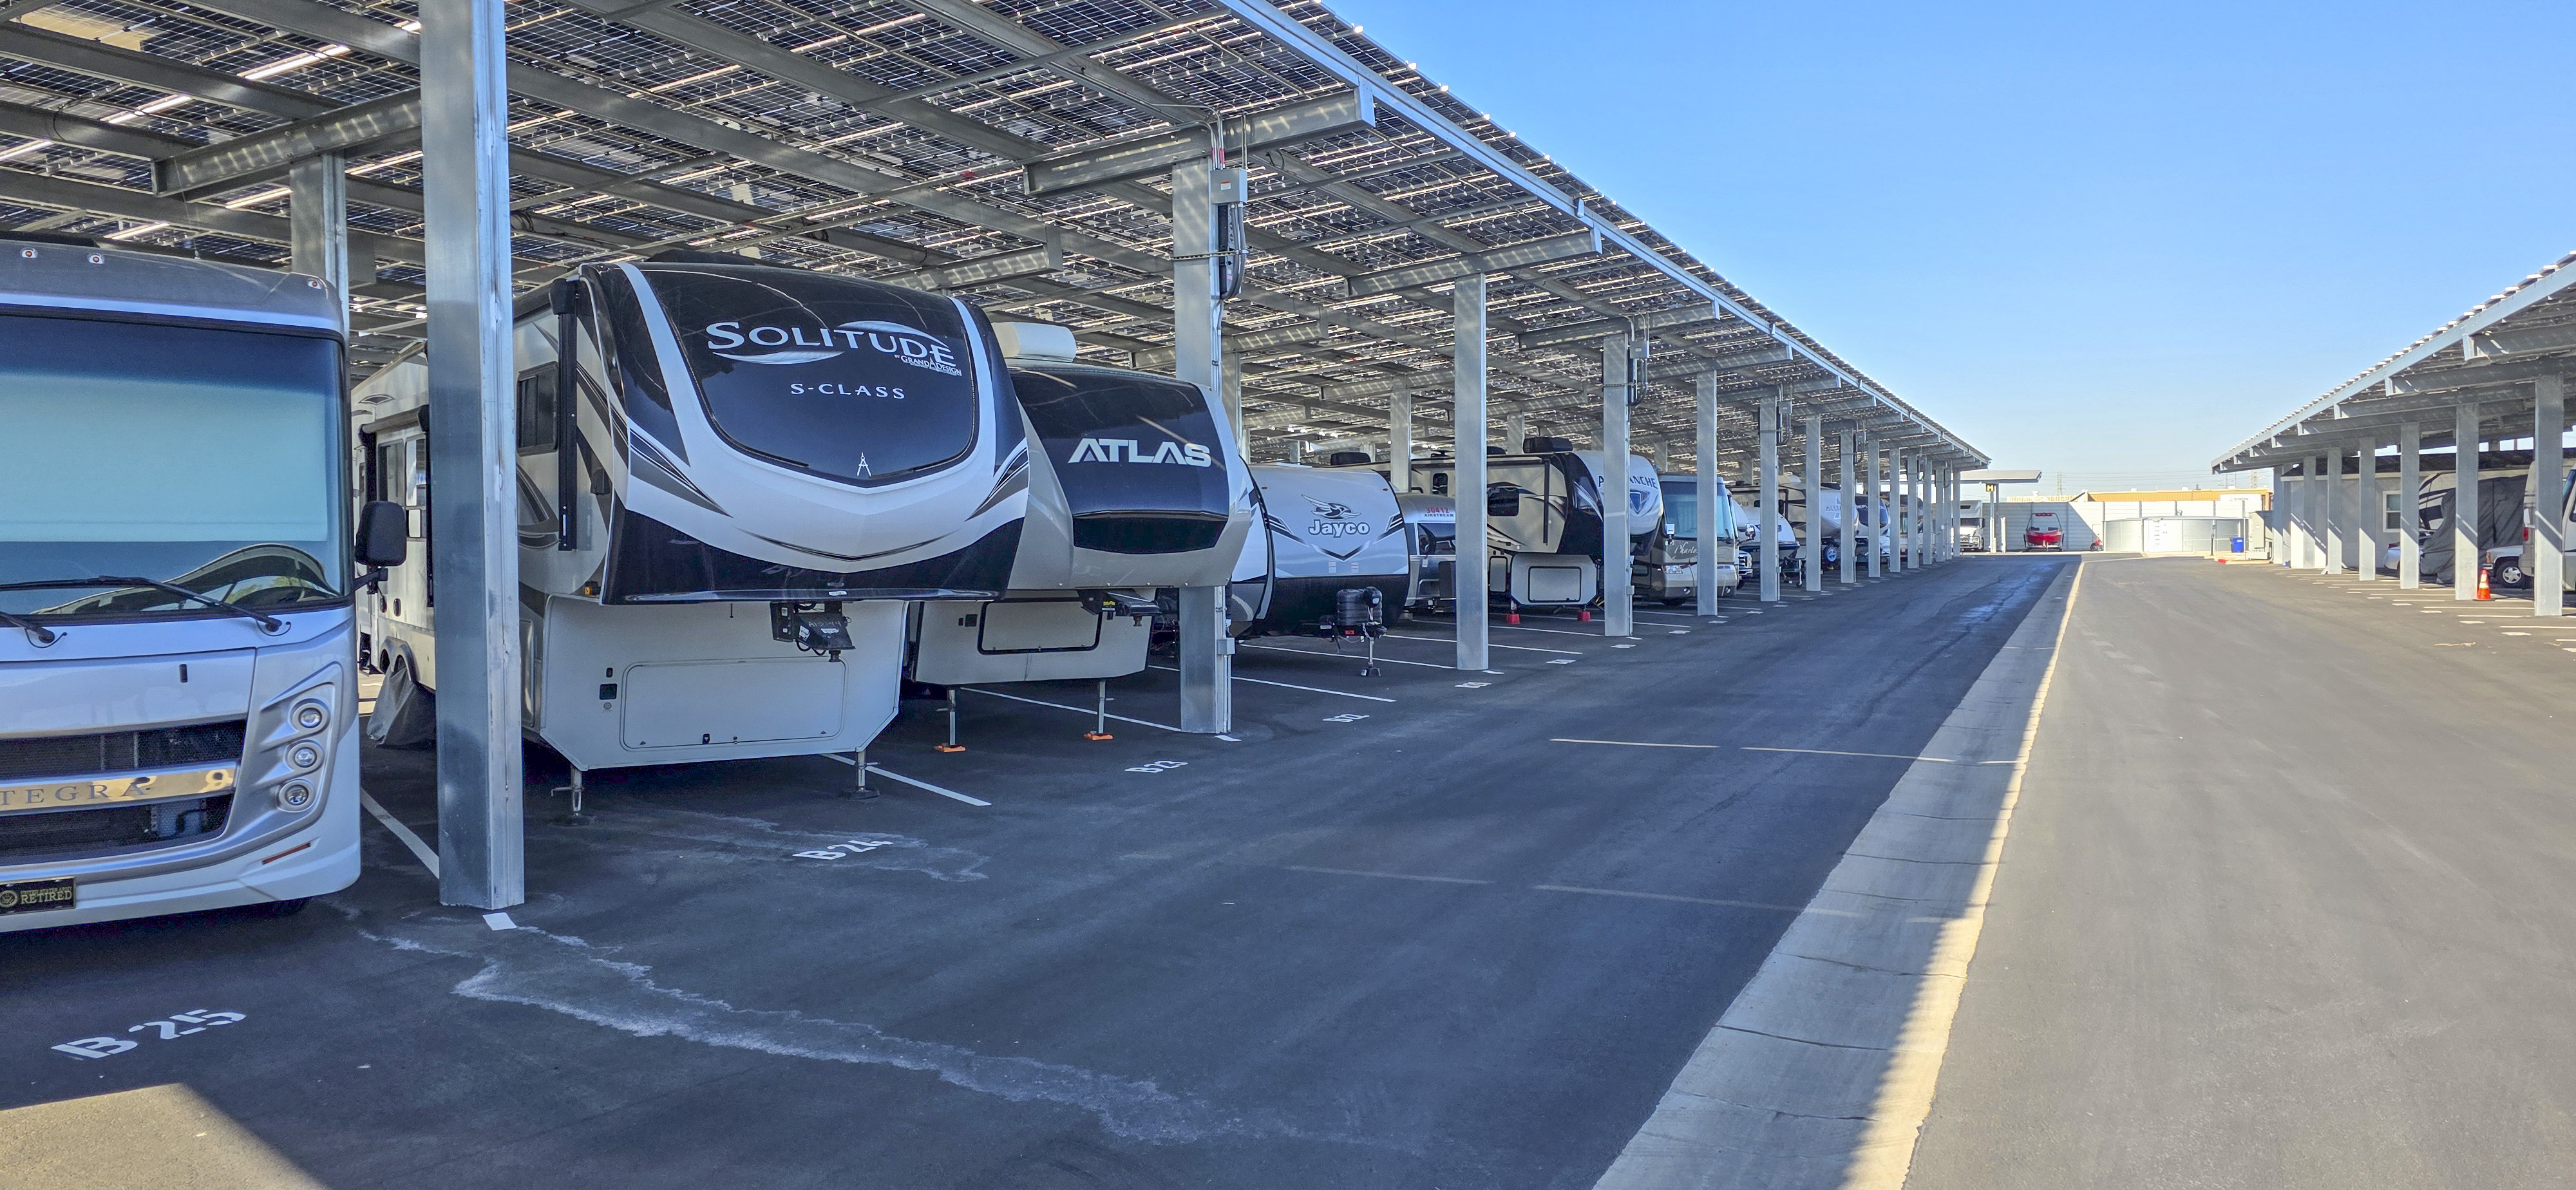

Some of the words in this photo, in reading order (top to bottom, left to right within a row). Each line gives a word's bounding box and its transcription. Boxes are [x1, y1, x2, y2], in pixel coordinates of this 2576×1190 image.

[706, 321, 957, 368] SOLITUDE
[791, 382, 905, 399] S-CLASS
[1067, 438, 1212, 468] ATLAS
[1308, 519, 1370, 538] Jayco
[1124, 760, 1188, 773] B23
[21, 891, 73, 904] RETIRED
